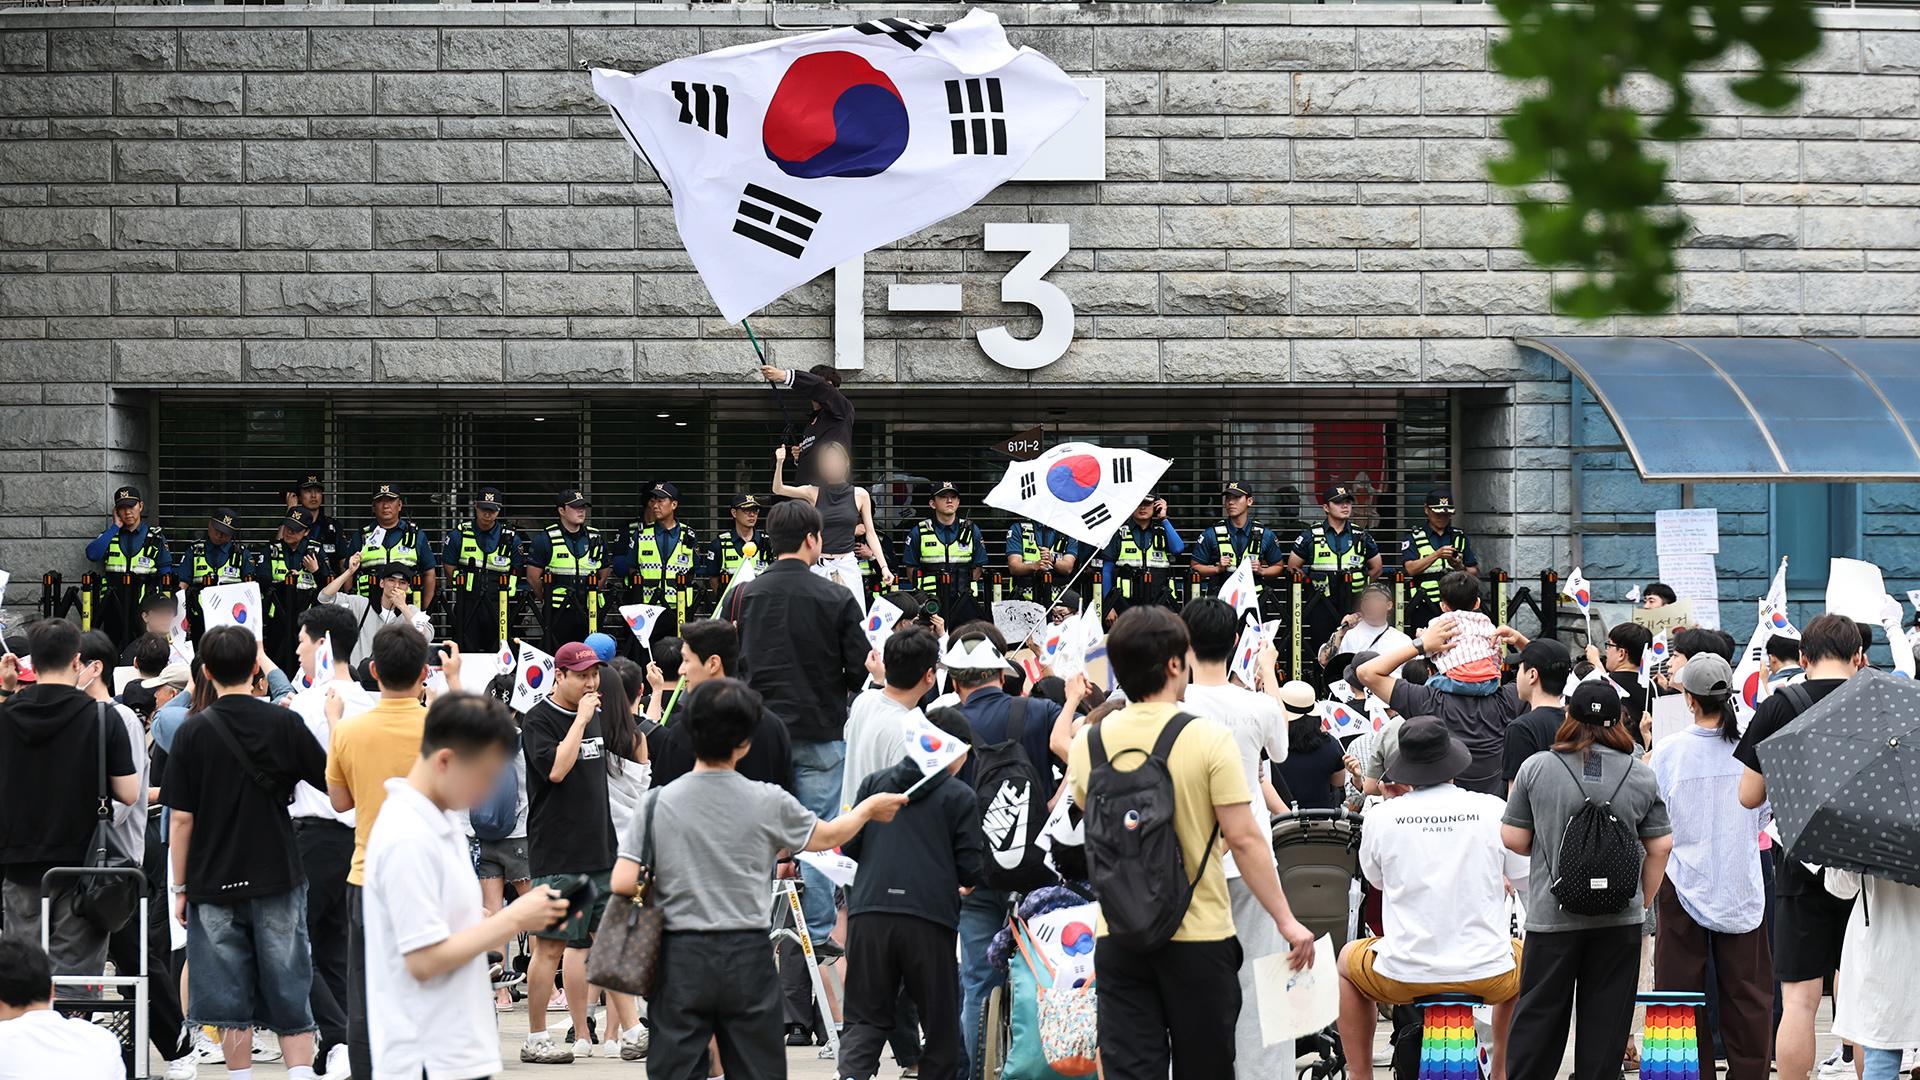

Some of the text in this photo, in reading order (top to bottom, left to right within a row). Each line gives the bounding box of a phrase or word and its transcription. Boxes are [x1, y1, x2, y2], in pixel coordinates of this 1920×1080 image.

[1008, 440, 1039, 452] 61기-2
[982, 780, 1022, 849] NIKE
[1395, 814, 1479, 824] WOOYOUNGMI
